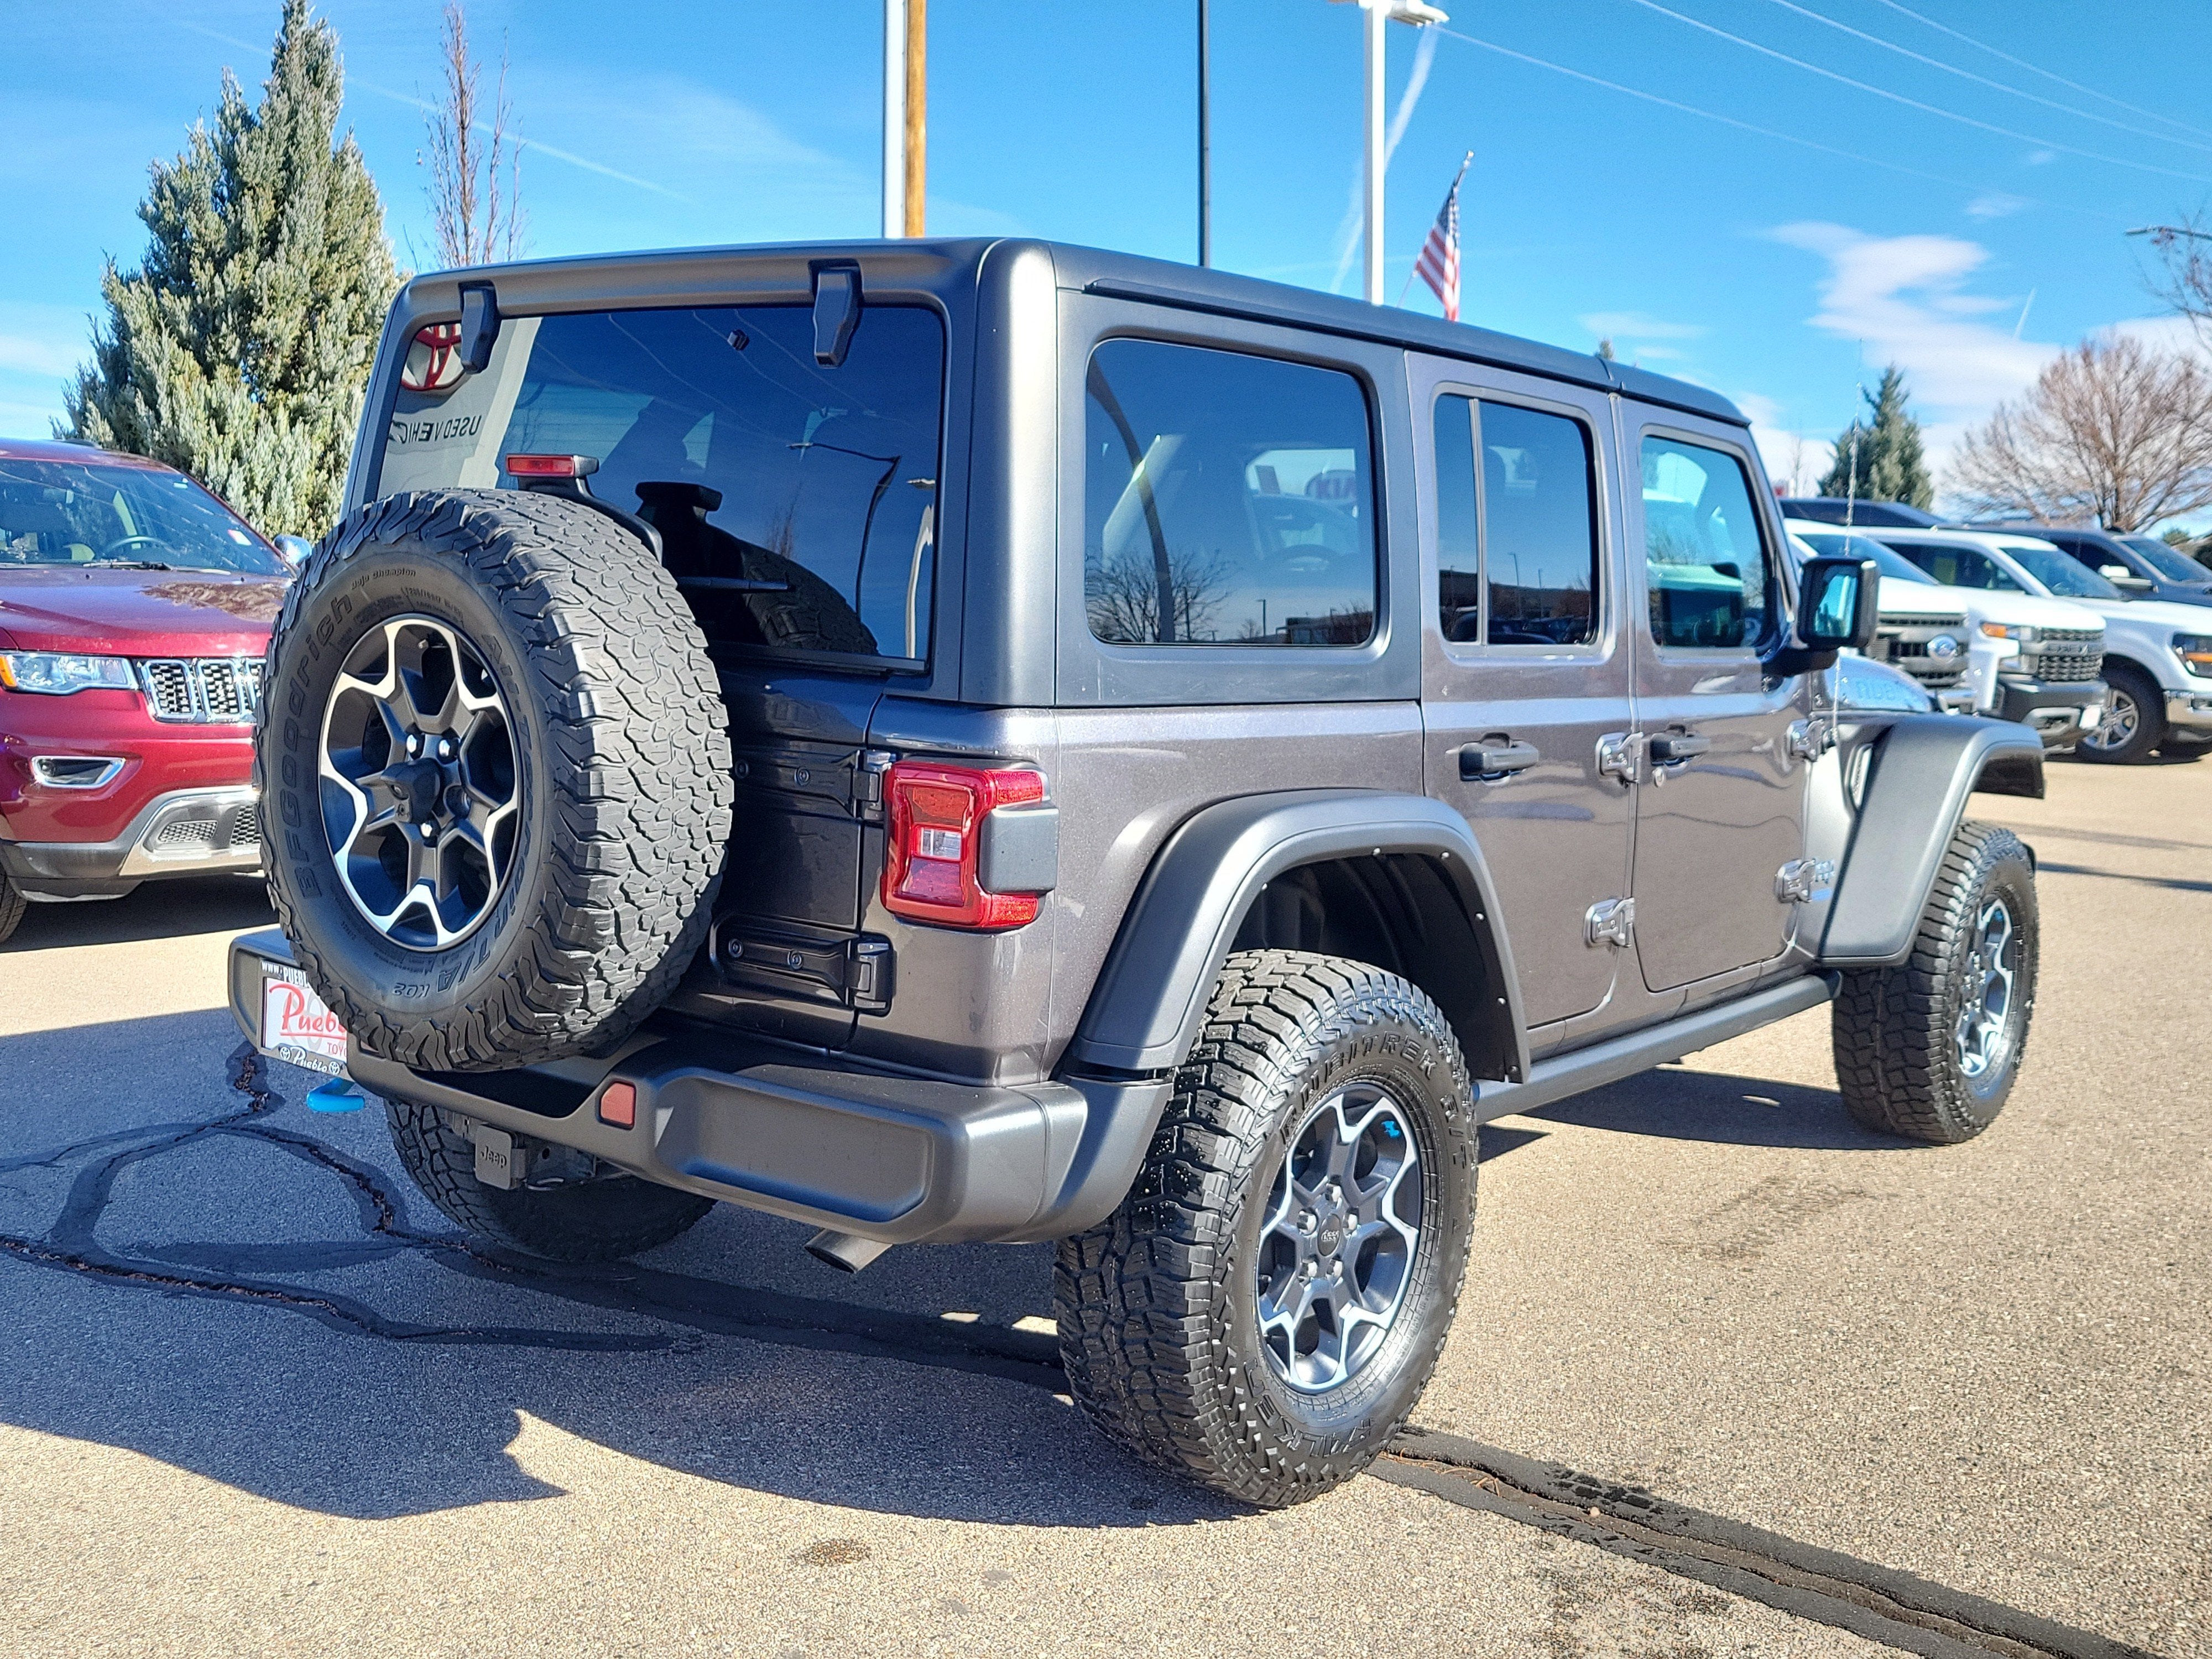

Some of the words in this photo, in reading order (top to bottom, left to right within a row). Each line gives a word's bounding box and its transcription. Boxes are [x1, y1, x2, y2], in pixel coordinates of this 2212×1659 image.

[280, 594, 352, 898] BFGoodrich
[392, 982, 431, 999] KO2
[269, 983, 348, 1034] Pueb
[290, 1046, 327, 1073] Pueblo
[480, 1145, 507, 1169] Jeep
